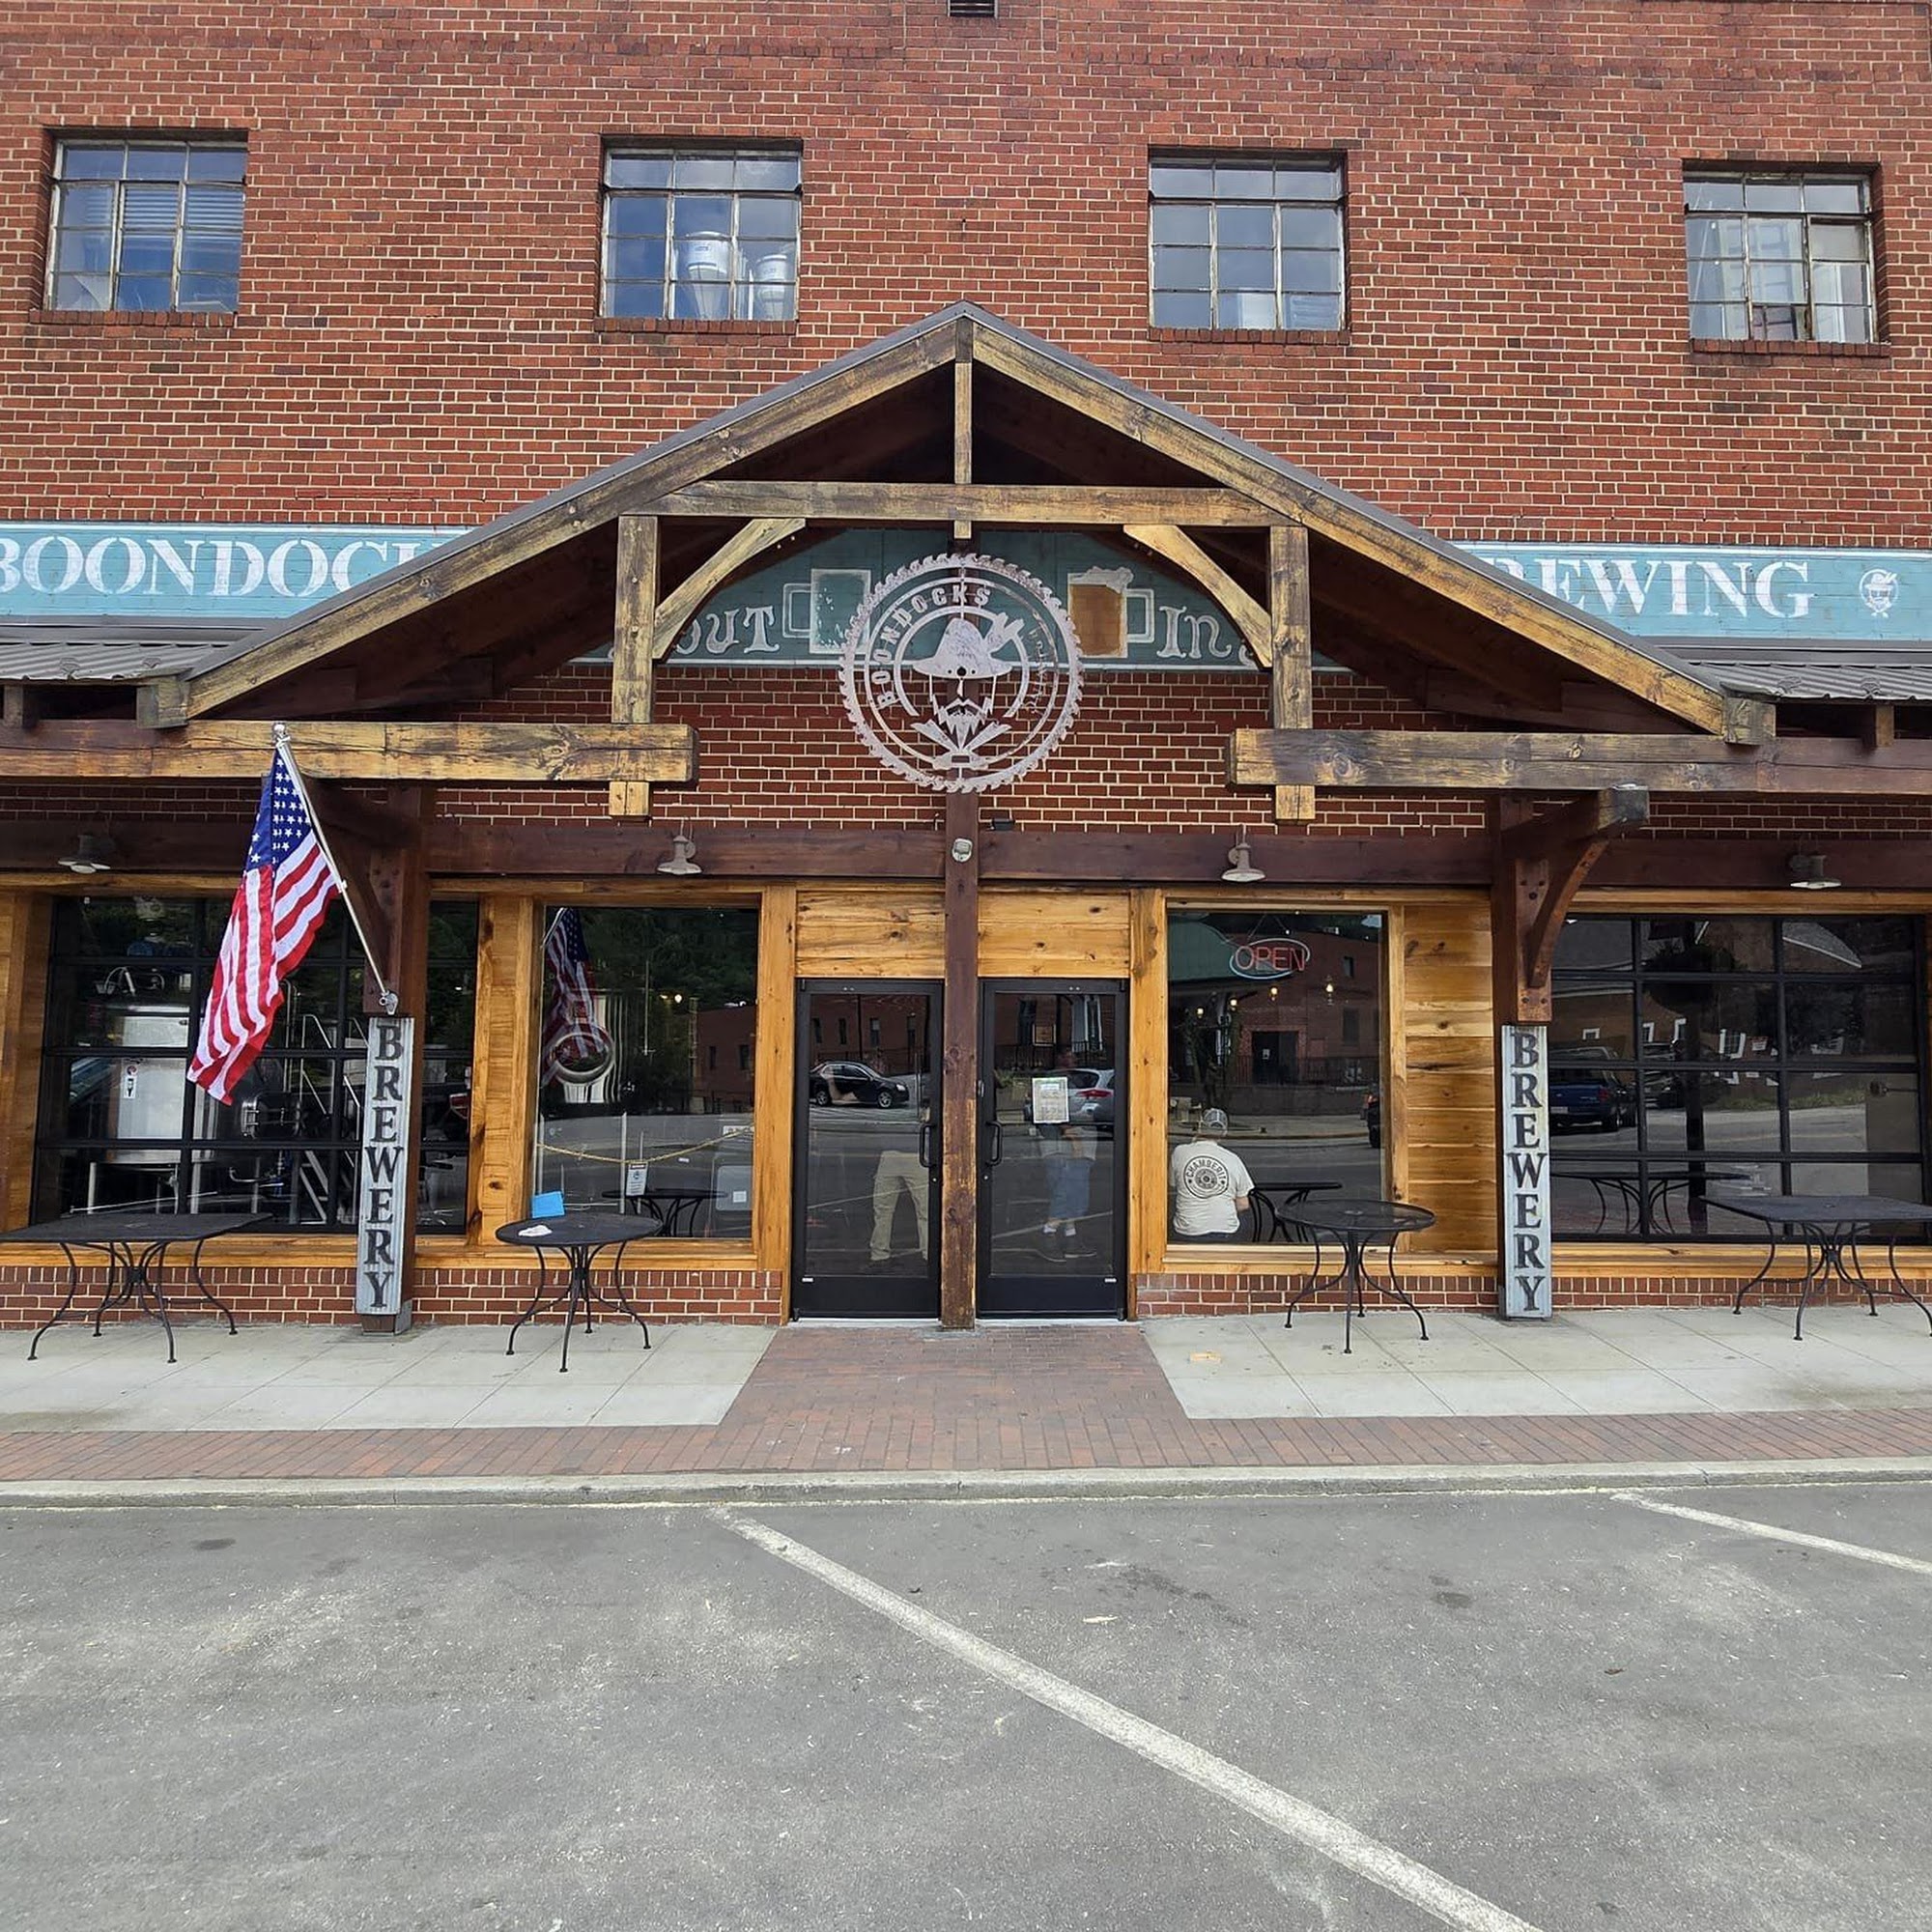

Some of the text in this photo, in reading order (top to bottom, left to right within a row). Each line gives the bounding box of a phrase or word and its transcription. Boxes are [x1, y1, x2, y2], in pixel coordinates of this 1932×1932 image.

[0, 535, 442, 597] BOONDOC
[871, 583, 991, 711] BOONDOCKS
[1236, 946, 1305, 972] OPEN
[363, 1024, 404, 1308] BREWERY
[1506, 1032, 1548, 1312] BREWERY
